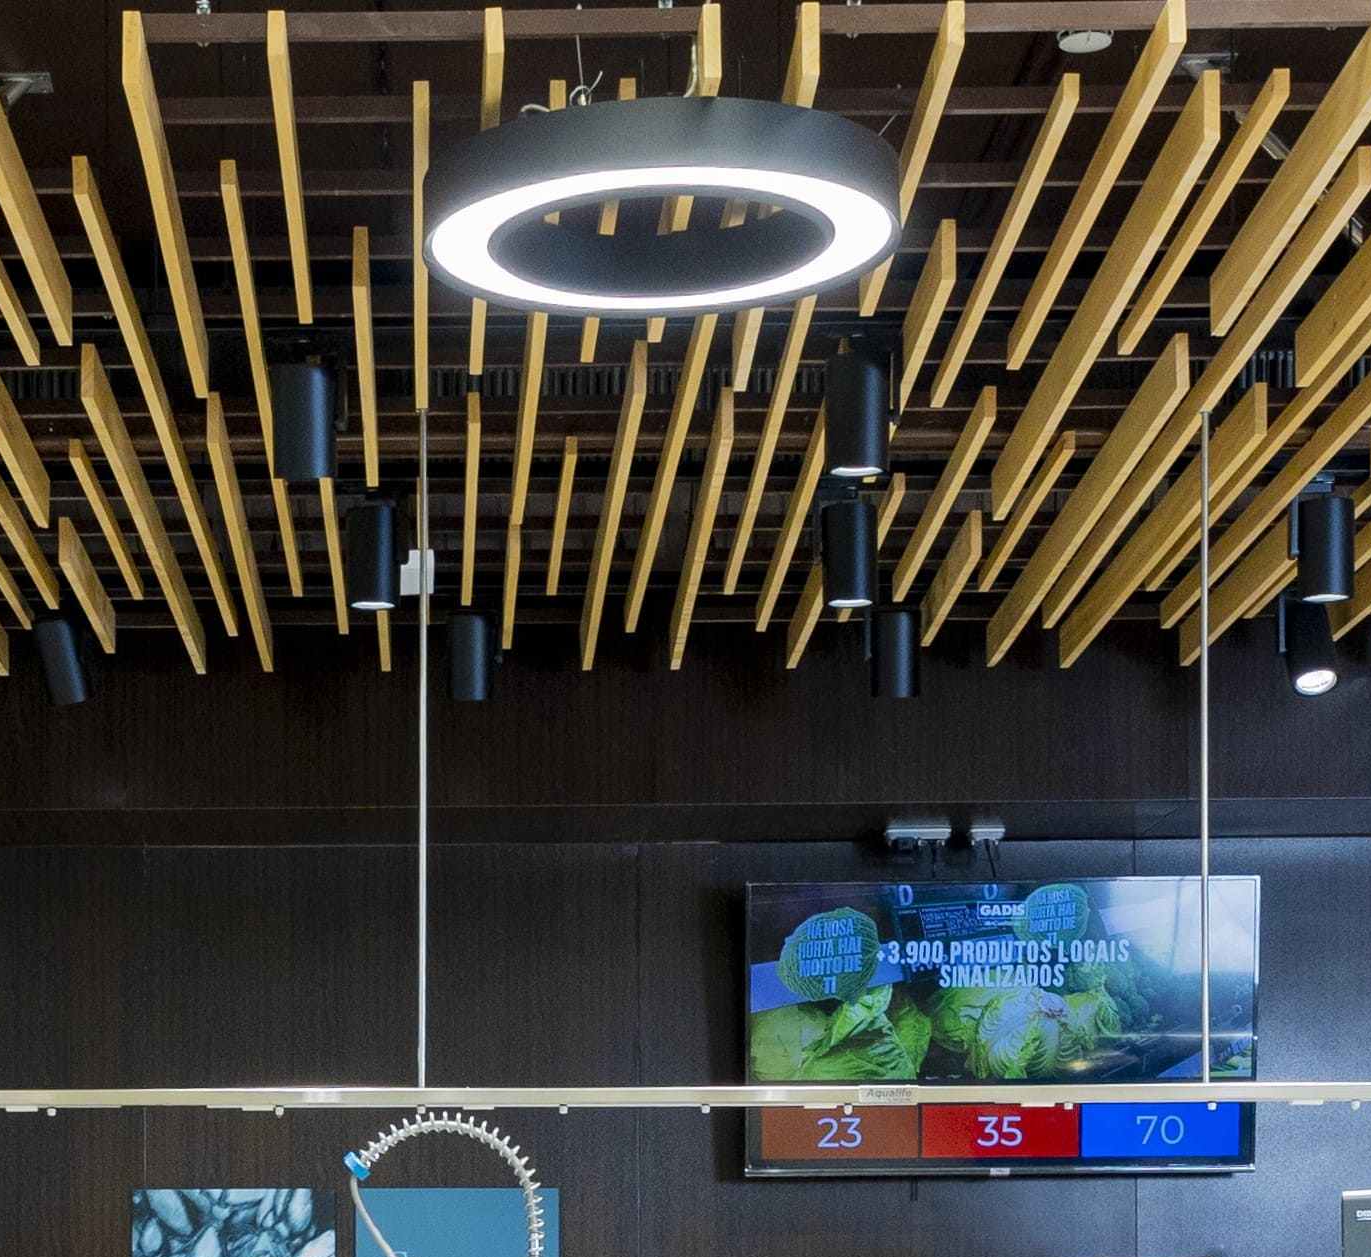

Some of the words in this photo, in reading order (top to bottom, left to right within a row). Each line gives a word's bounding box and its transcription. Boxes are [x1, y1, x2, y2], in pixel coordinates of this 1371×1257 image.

[980, 905, 1026, 916] GADIS
[877, 940, 944, 965] +3.900
[949, 940, 1052, 964] PRODUTOS
[1057, 939, 1131, 964] LOCAIS
[939, 964, 1065, 988] SINALIZADOS
[817, 1117, 862, 1148] 23
[976, 1116, 1023, 1147] 35
[1136, 1115, 1184, 1144] 70
